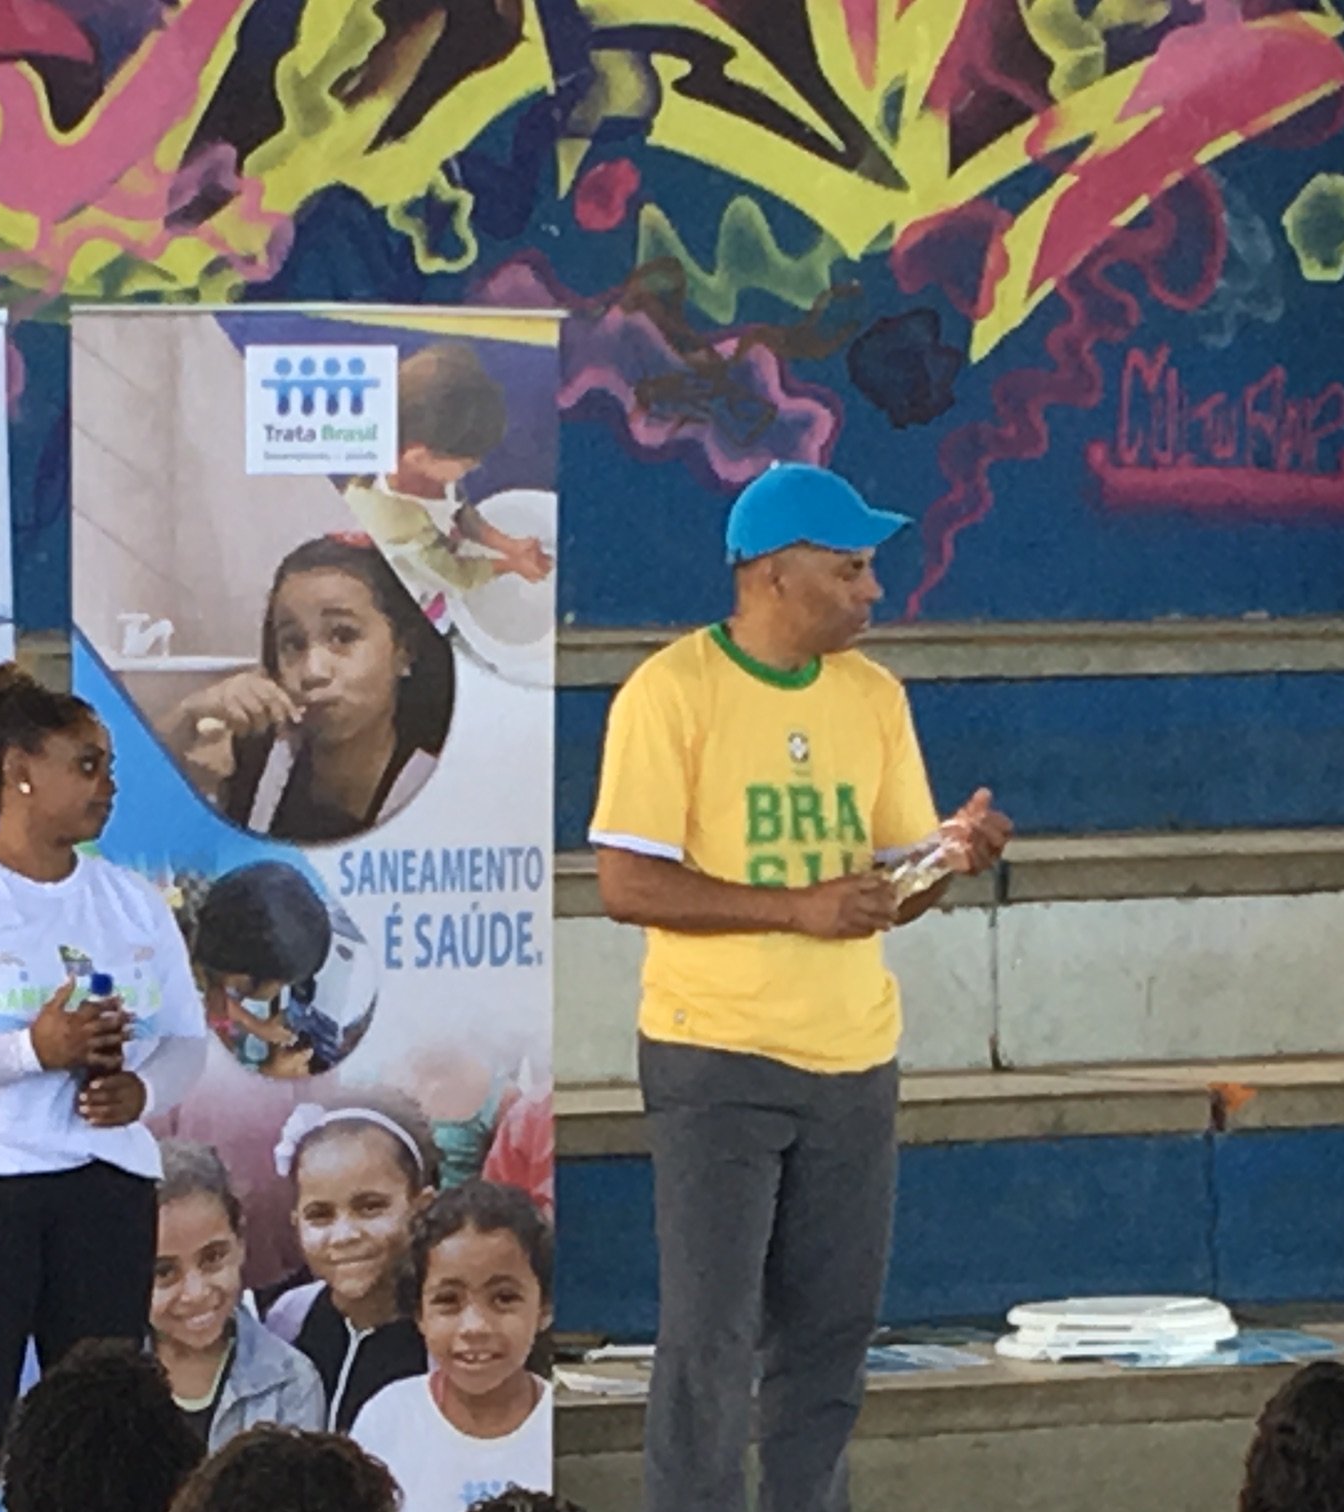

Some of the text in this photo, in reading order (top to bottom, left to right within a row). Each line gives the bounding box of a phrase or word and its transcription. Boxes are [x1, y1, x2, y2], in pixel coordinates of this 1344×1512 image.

[263, 424, 378, 443] Trata Brasil
[745, 782, 867, 845] BRA
[339, 846, 544, 896] SANEAMENTO
[384, 900, 543, 970] É SAÚDE.
